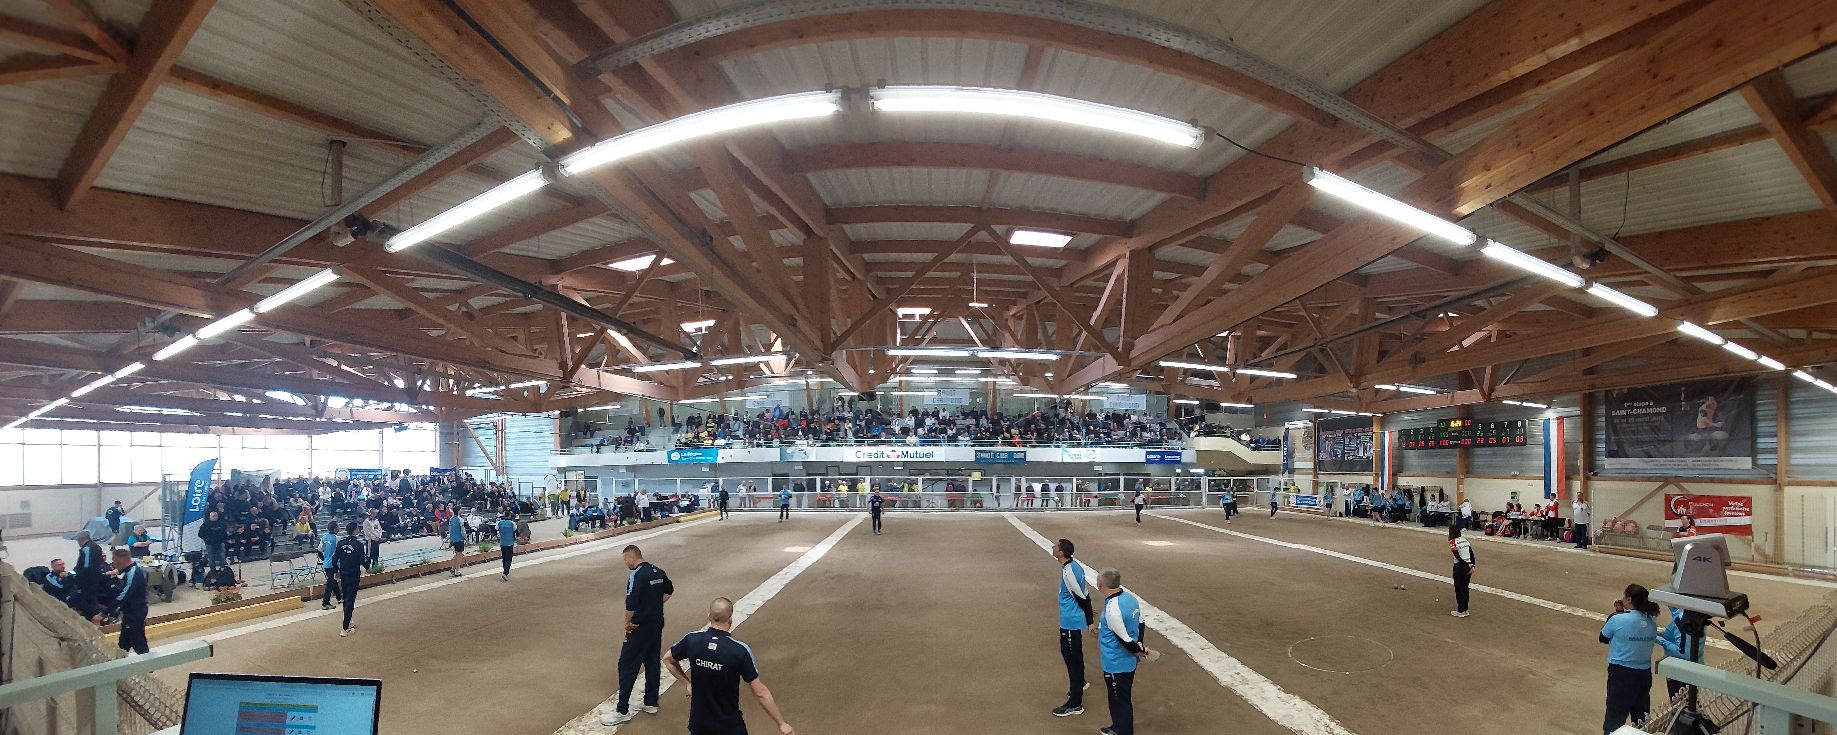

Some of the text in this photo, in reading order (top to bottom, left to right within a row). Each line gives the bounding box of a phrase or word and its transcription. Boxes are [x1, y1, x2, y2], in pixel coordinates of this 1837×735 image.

[900, 450, 934, 459] Mutuel
[189, 479, 205, 513] Loire
[1692, 555, 1713, 564] 4K
[695, 658, 723, 671] CHIRAT
